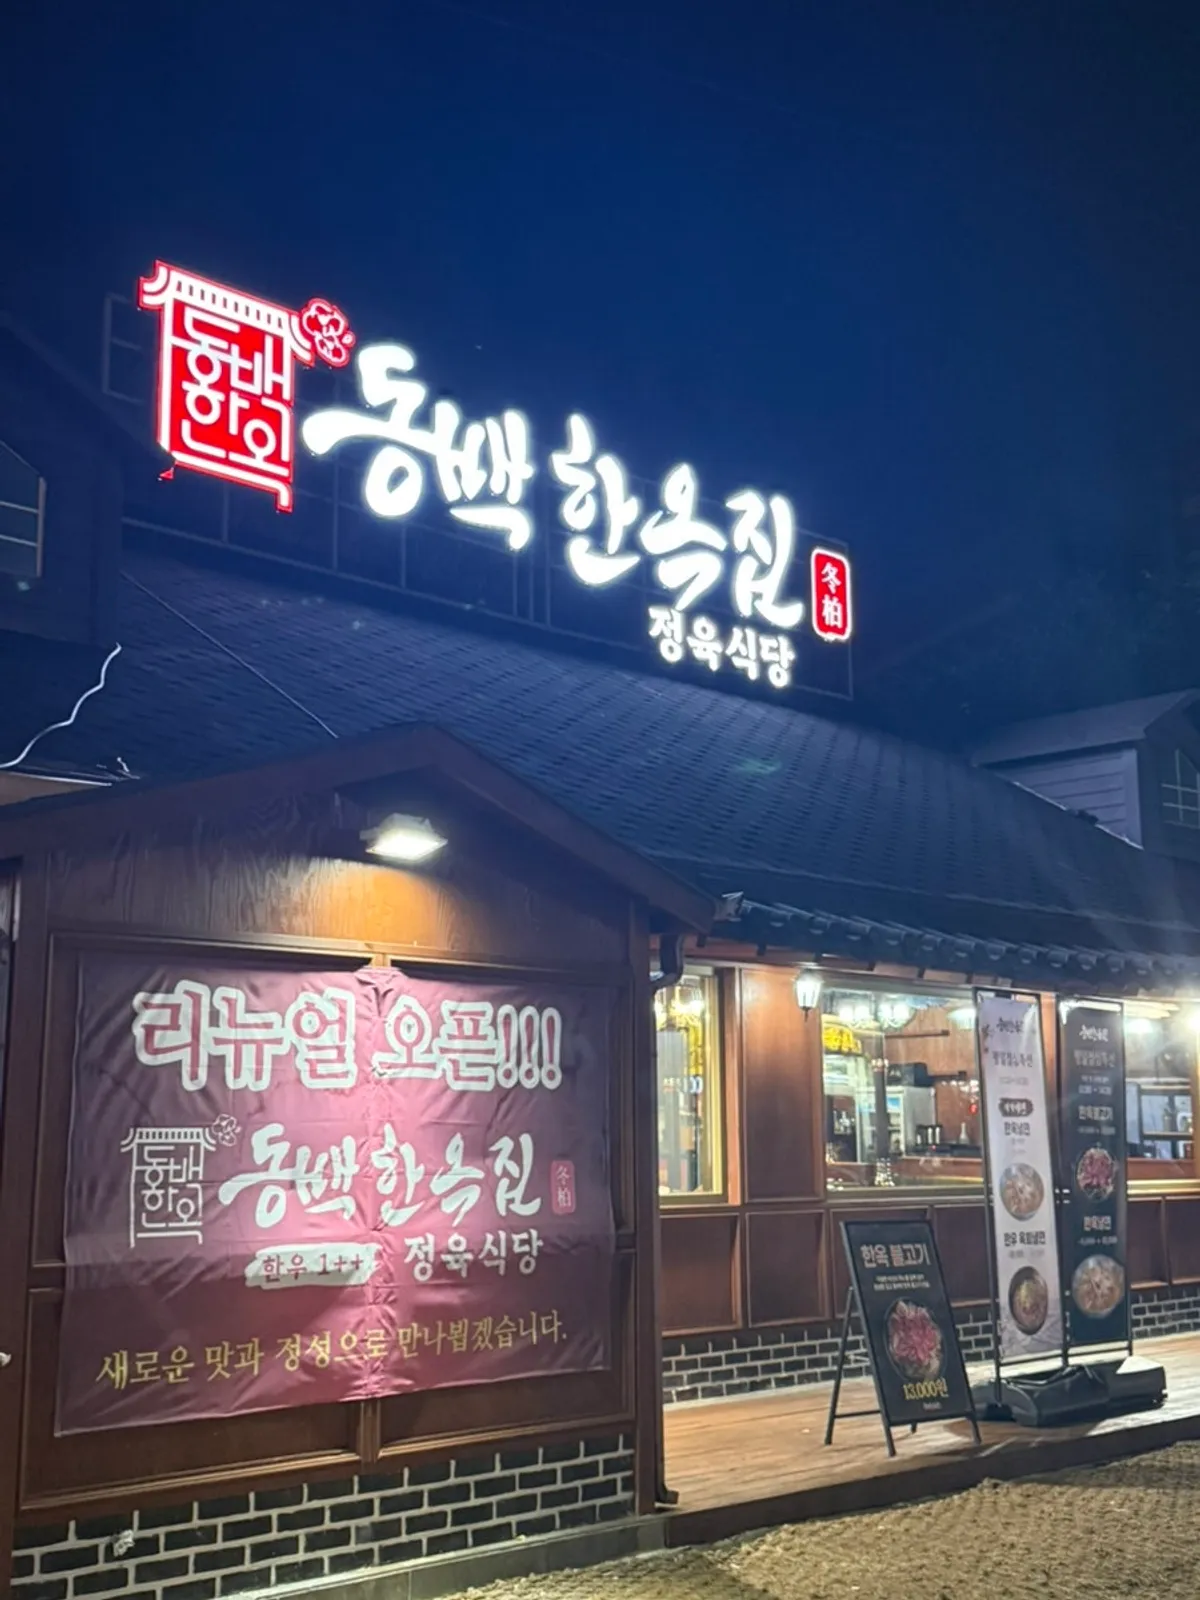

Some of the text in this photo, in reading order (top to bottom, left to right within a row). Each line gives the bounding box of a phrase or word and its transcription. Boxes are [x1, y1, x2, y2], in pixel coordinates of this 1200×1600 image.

[302, 343, 803, 629] 동백 한옥집
[647, 605, 796, 688] 정육식당
[132, 980, 562, 1091] 리뉴얼 오픈!!!
[218, 1123, 542, 1229] 동백 한옥집
[263, 1253, 364, 1283] 한우 1++
[404, 1228, 544, 1282] 정육식당
[860, 1243, 931, 1268] 한옥 불고기
[96, 1346, 195, 1390] 새로운
[205, 1338, 264, 1382] 맛과
[275, 1329, 389, 1371] 정성으로
